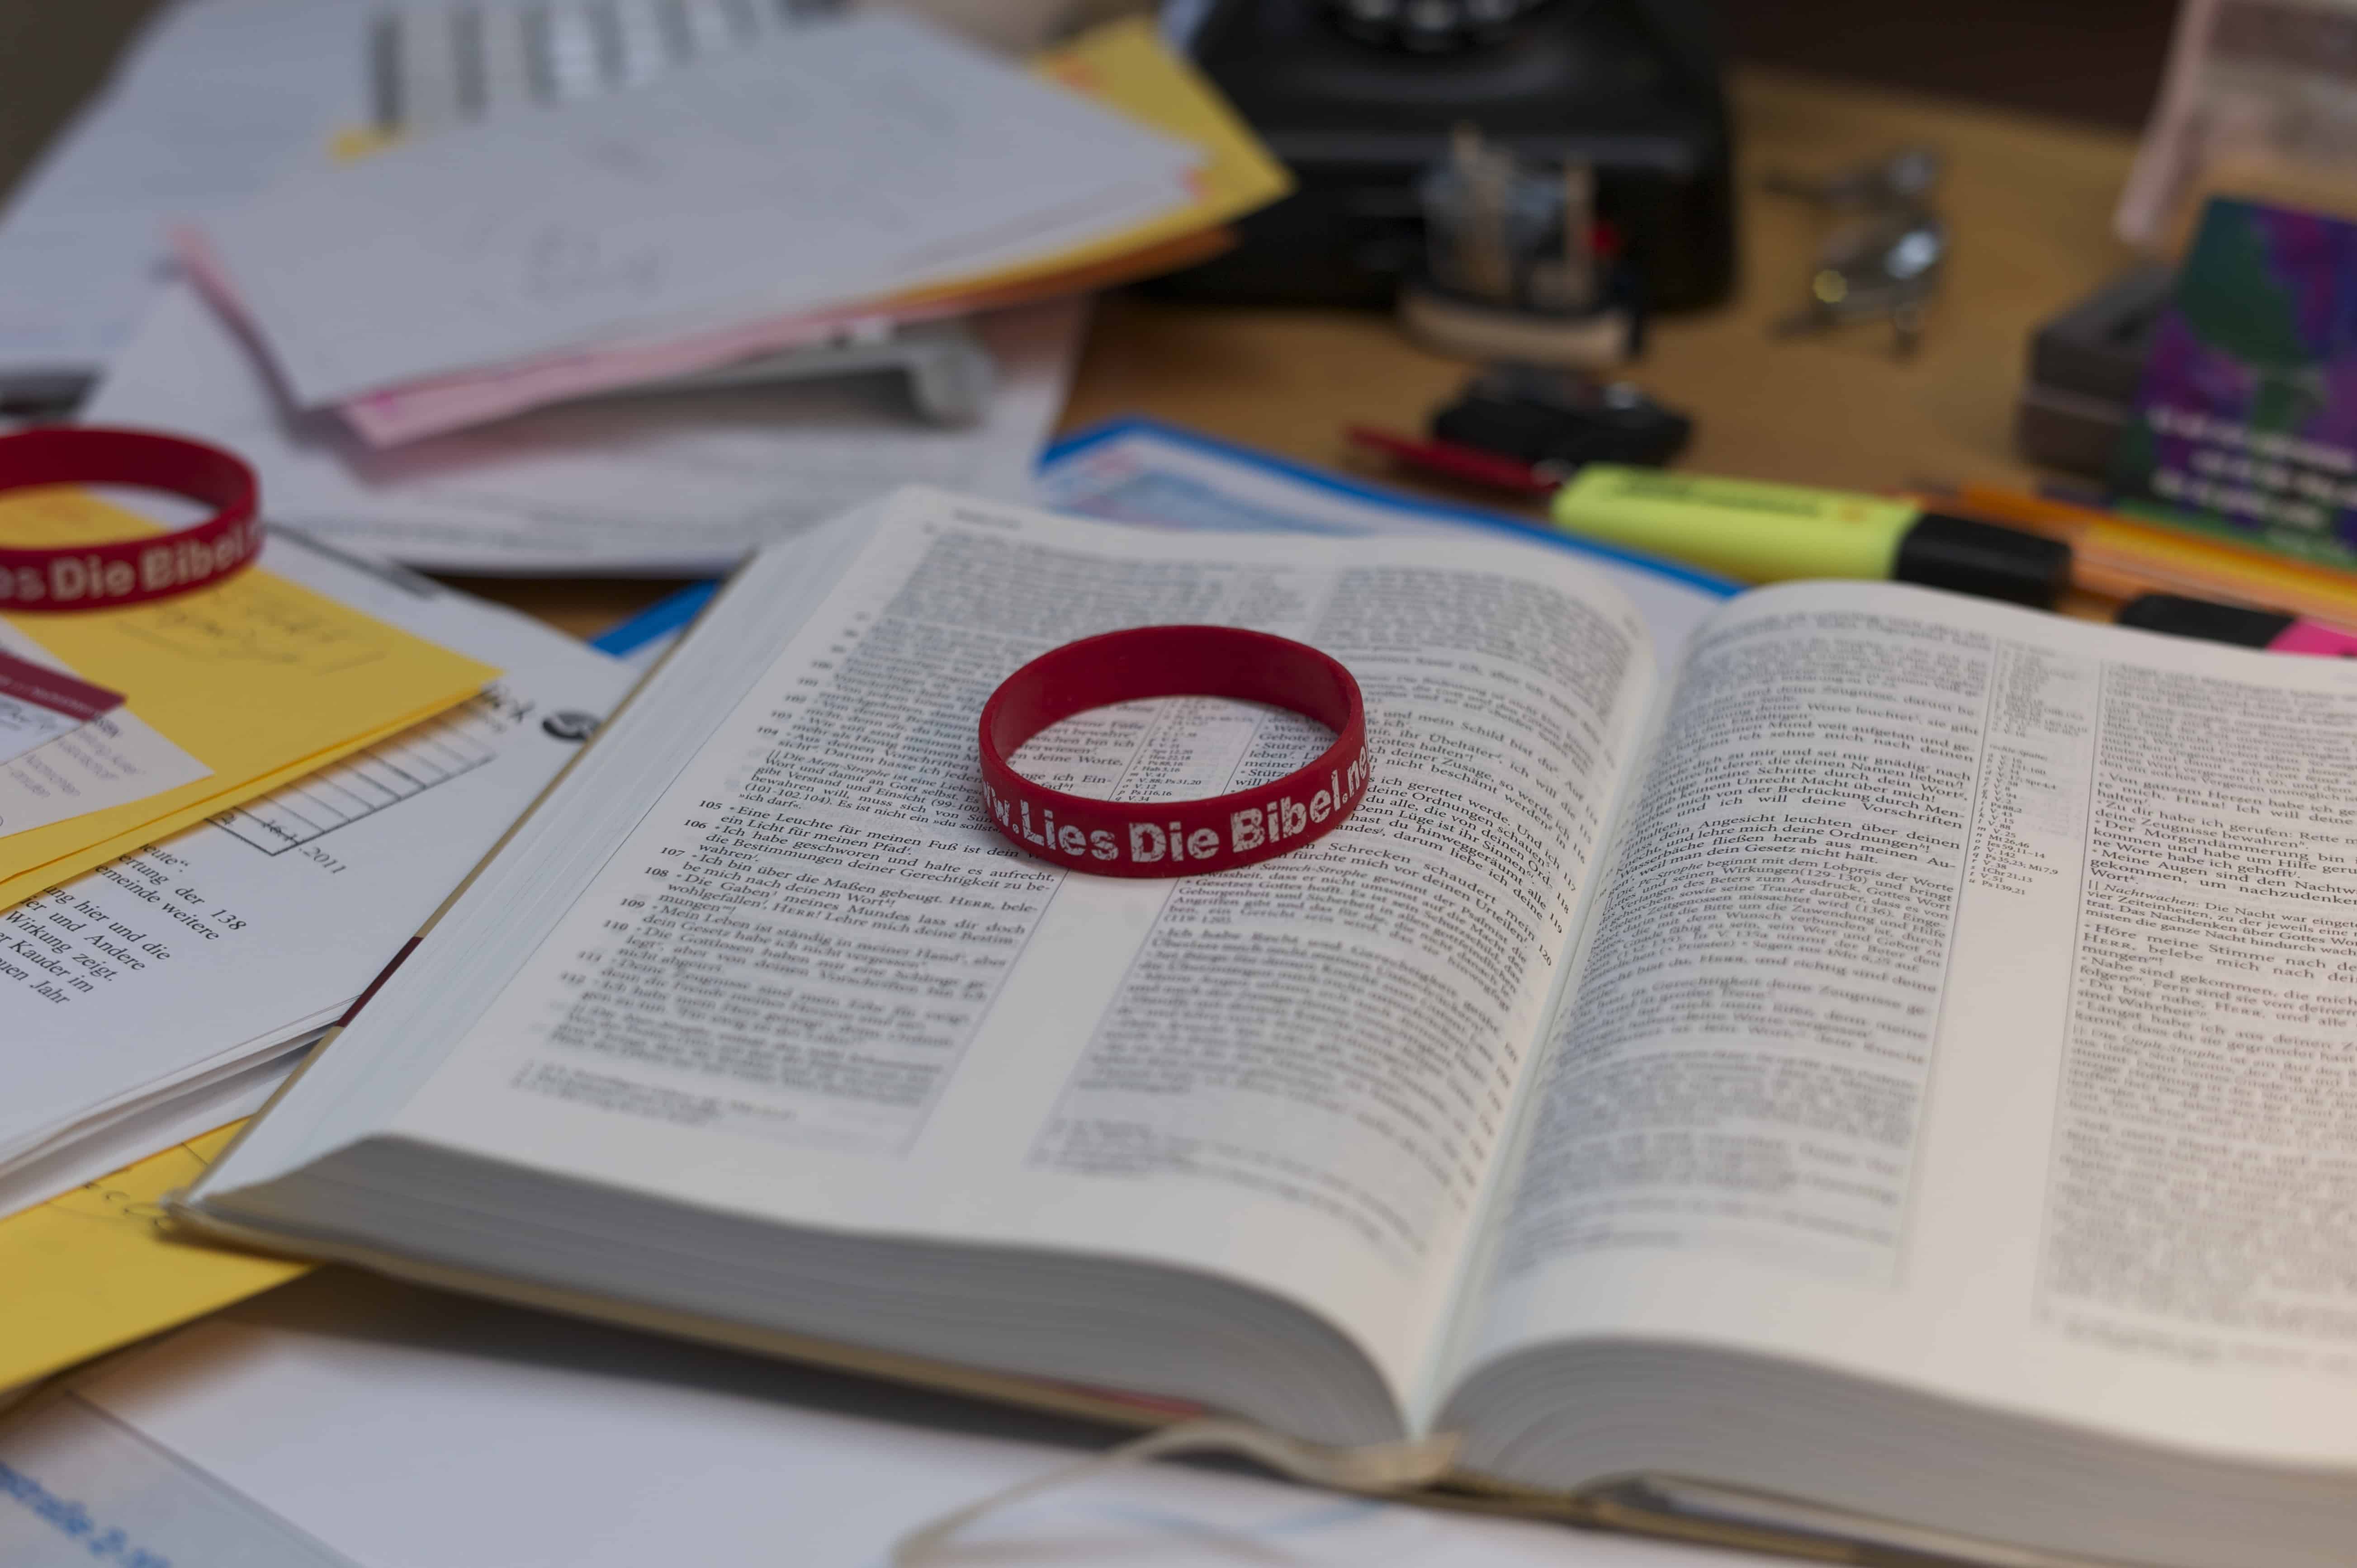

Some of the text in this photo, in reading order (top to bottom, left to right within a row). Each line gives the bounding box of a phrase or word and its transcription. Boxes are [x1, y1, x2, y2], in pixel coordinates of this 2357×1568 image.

[51, 555, 134, 601] Die
[1033, 753, 1123, 766] deine Worte,
[1245, 760, 1295, 768] meiner
[1053, 773, 1112, 784] ich Ein-
[1130, 822, 1220, 862] Die
[1231, 729, 1369, 852] Bibel.ne
[1407, 782, 1462, 802] gerettet
[699, 800, 723, 810] 105
[777, 813, 833, 830] Leuchte
[867, 831, 921, 846] meinen
[1412, 792, 1493, 827] Ordnungen
[1699, 814, 1775, 829] Angesicht
[1784, 813, 1852, 828] leuchten
[1862, 803, 1962, 829] Vorschriften
[684, 819, 707, 829] 106
[814, 831, 868, 848] meinen
[1481, 829, 1524, 860] deinen
[2144, 828, 2309, 861] Morgendämmerung
[661, 847, 684, 857] 107
[732, 839, 842, 865] Bestimmungen
[900, 869, 999, 888] Gerechtigkeit
[795, 841, 880, 861] geschworen
[990, 869, 1055, 882] aufrecht,
[1416, 825, 1524, 886] hinweggeräumt
[2090, 859, 2187, 884] gekommen,
[1329, 842, 1411, 864] Schrecken
[1424, 863, 1498, 905] schaudert
[74, 900, 110, 922] hier
[109, 921, 147, 943] und
[142, 942, 170, 960] die
[162, 902, 219, 940] weitere
[211, 909, 247, 930] 138
[5, 910, 118, 982] Wirkung zeigt.
[49, 912, 146, 971] und Andere
[8, 940, 94, 993] Kauder im
[30, 980, 71, 1004] Jahr
